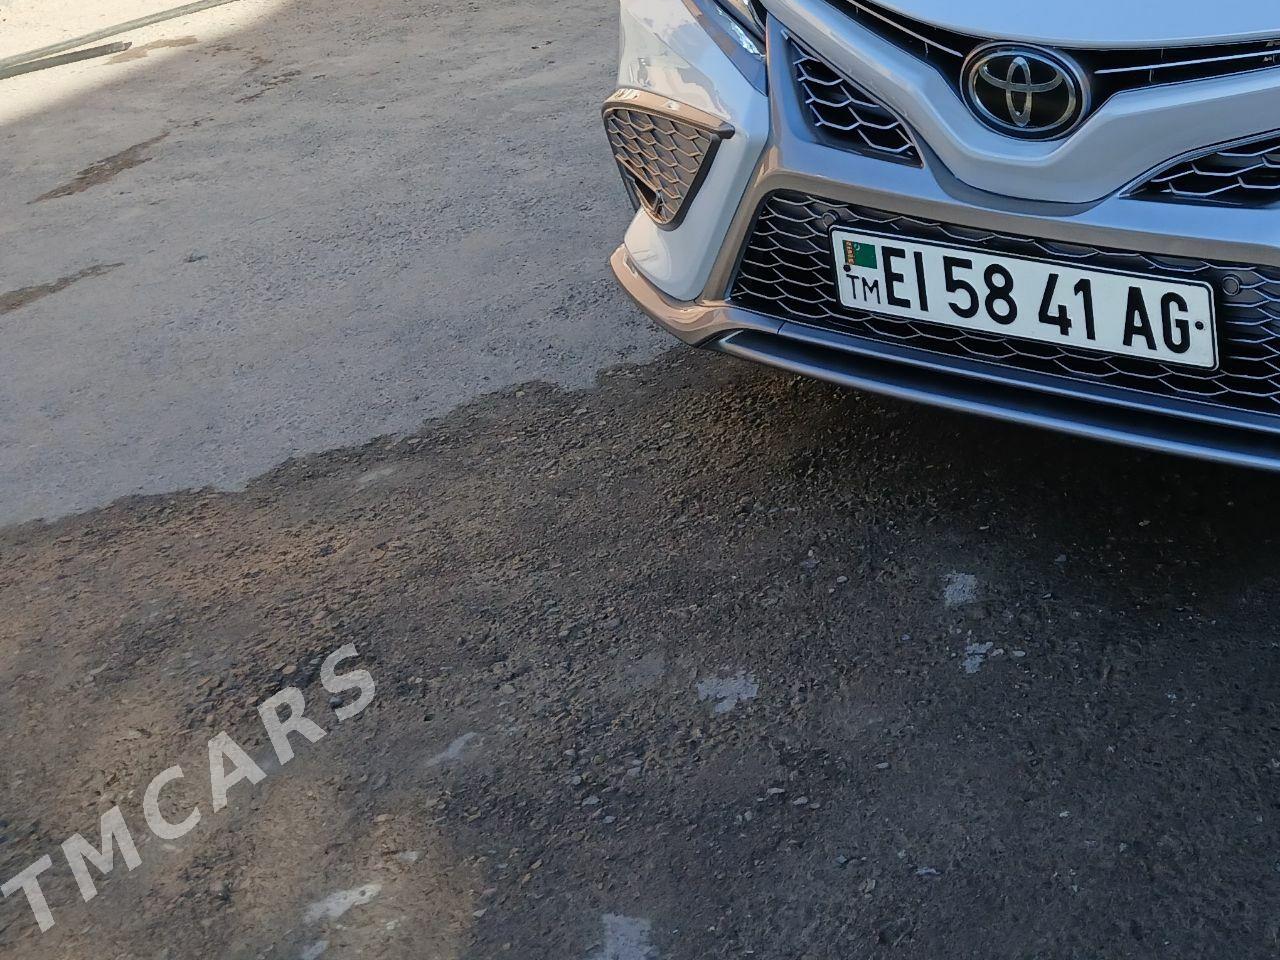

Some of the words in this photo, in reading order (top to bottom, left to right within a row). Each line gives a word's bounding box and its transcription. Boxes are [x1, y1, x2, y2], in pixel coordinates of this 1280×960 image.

[845, 272, 881, 305] TM
[942, 255, 1018, 325] 58
[1038, 272, 1096, 341] 41
[1122, 285, 1190, 354] AG
